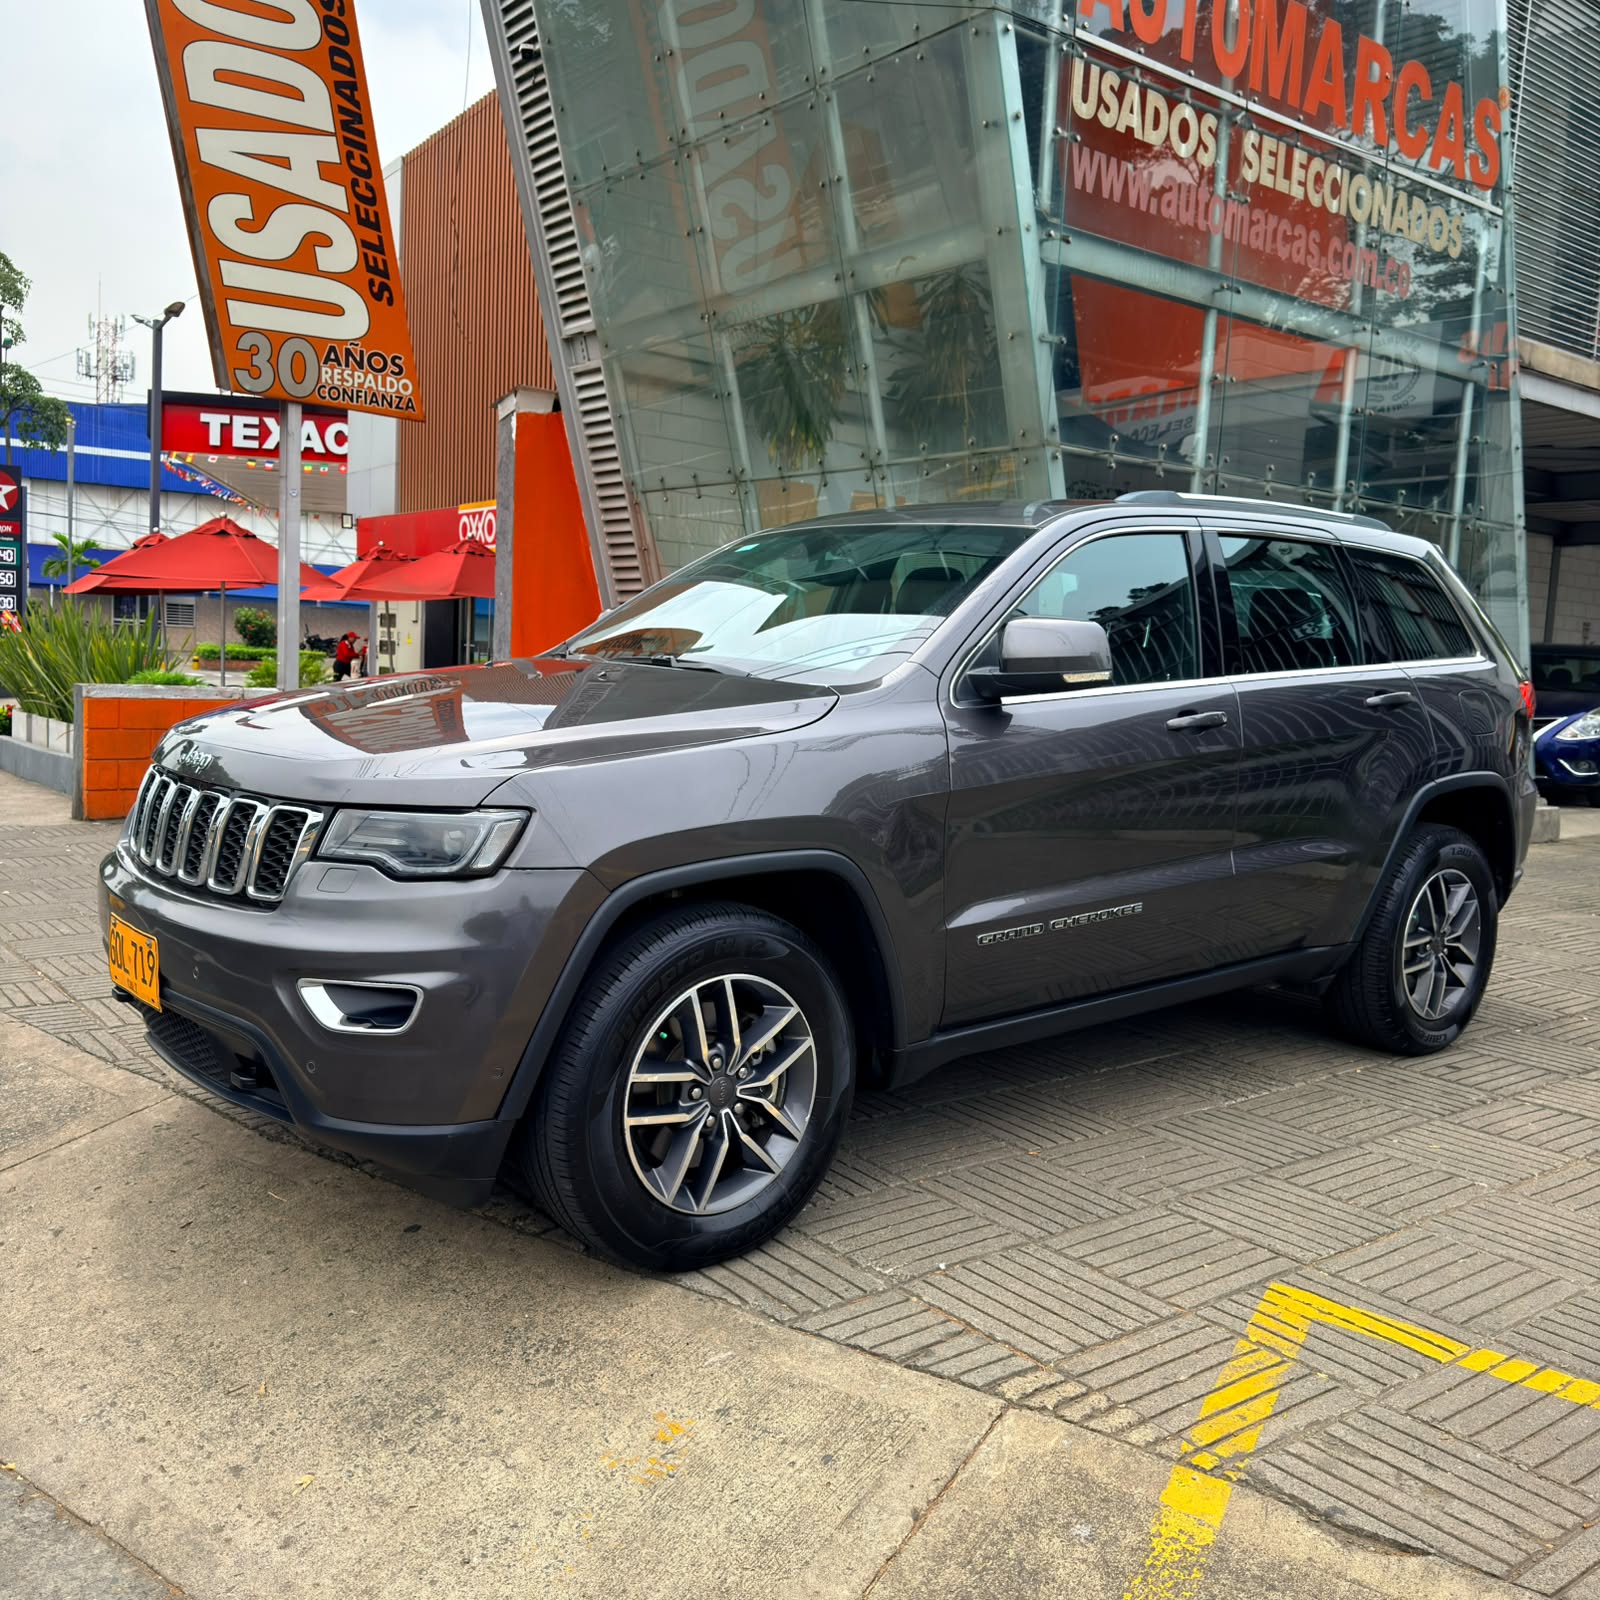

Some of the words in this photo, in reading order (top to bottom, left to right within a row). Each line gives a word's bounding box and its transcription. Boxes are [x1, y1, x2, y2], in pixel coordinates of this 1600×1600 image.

[1079, 0, 1502, 191] OMARCAS
[1072, 57, 1218, 168] USADOS
[1242, 130, 1463, 259] SELECCIONADOS
[1071, 142, 1411, 299] www.automarcas.com.co
[234, 331, 320, 398] 30
[322, 342, 405, 377] AÑOS
[321, 367, 413, 395] RESPALDO
[316, 385, 416, 412] CONFIANZA
[459, 510, 496, 544] OXXO
[976, 922, 1044, 946] GRAND
[1050, 902, 1143, 931] CHEROKEE
[131, 940, 155, 988] 719
